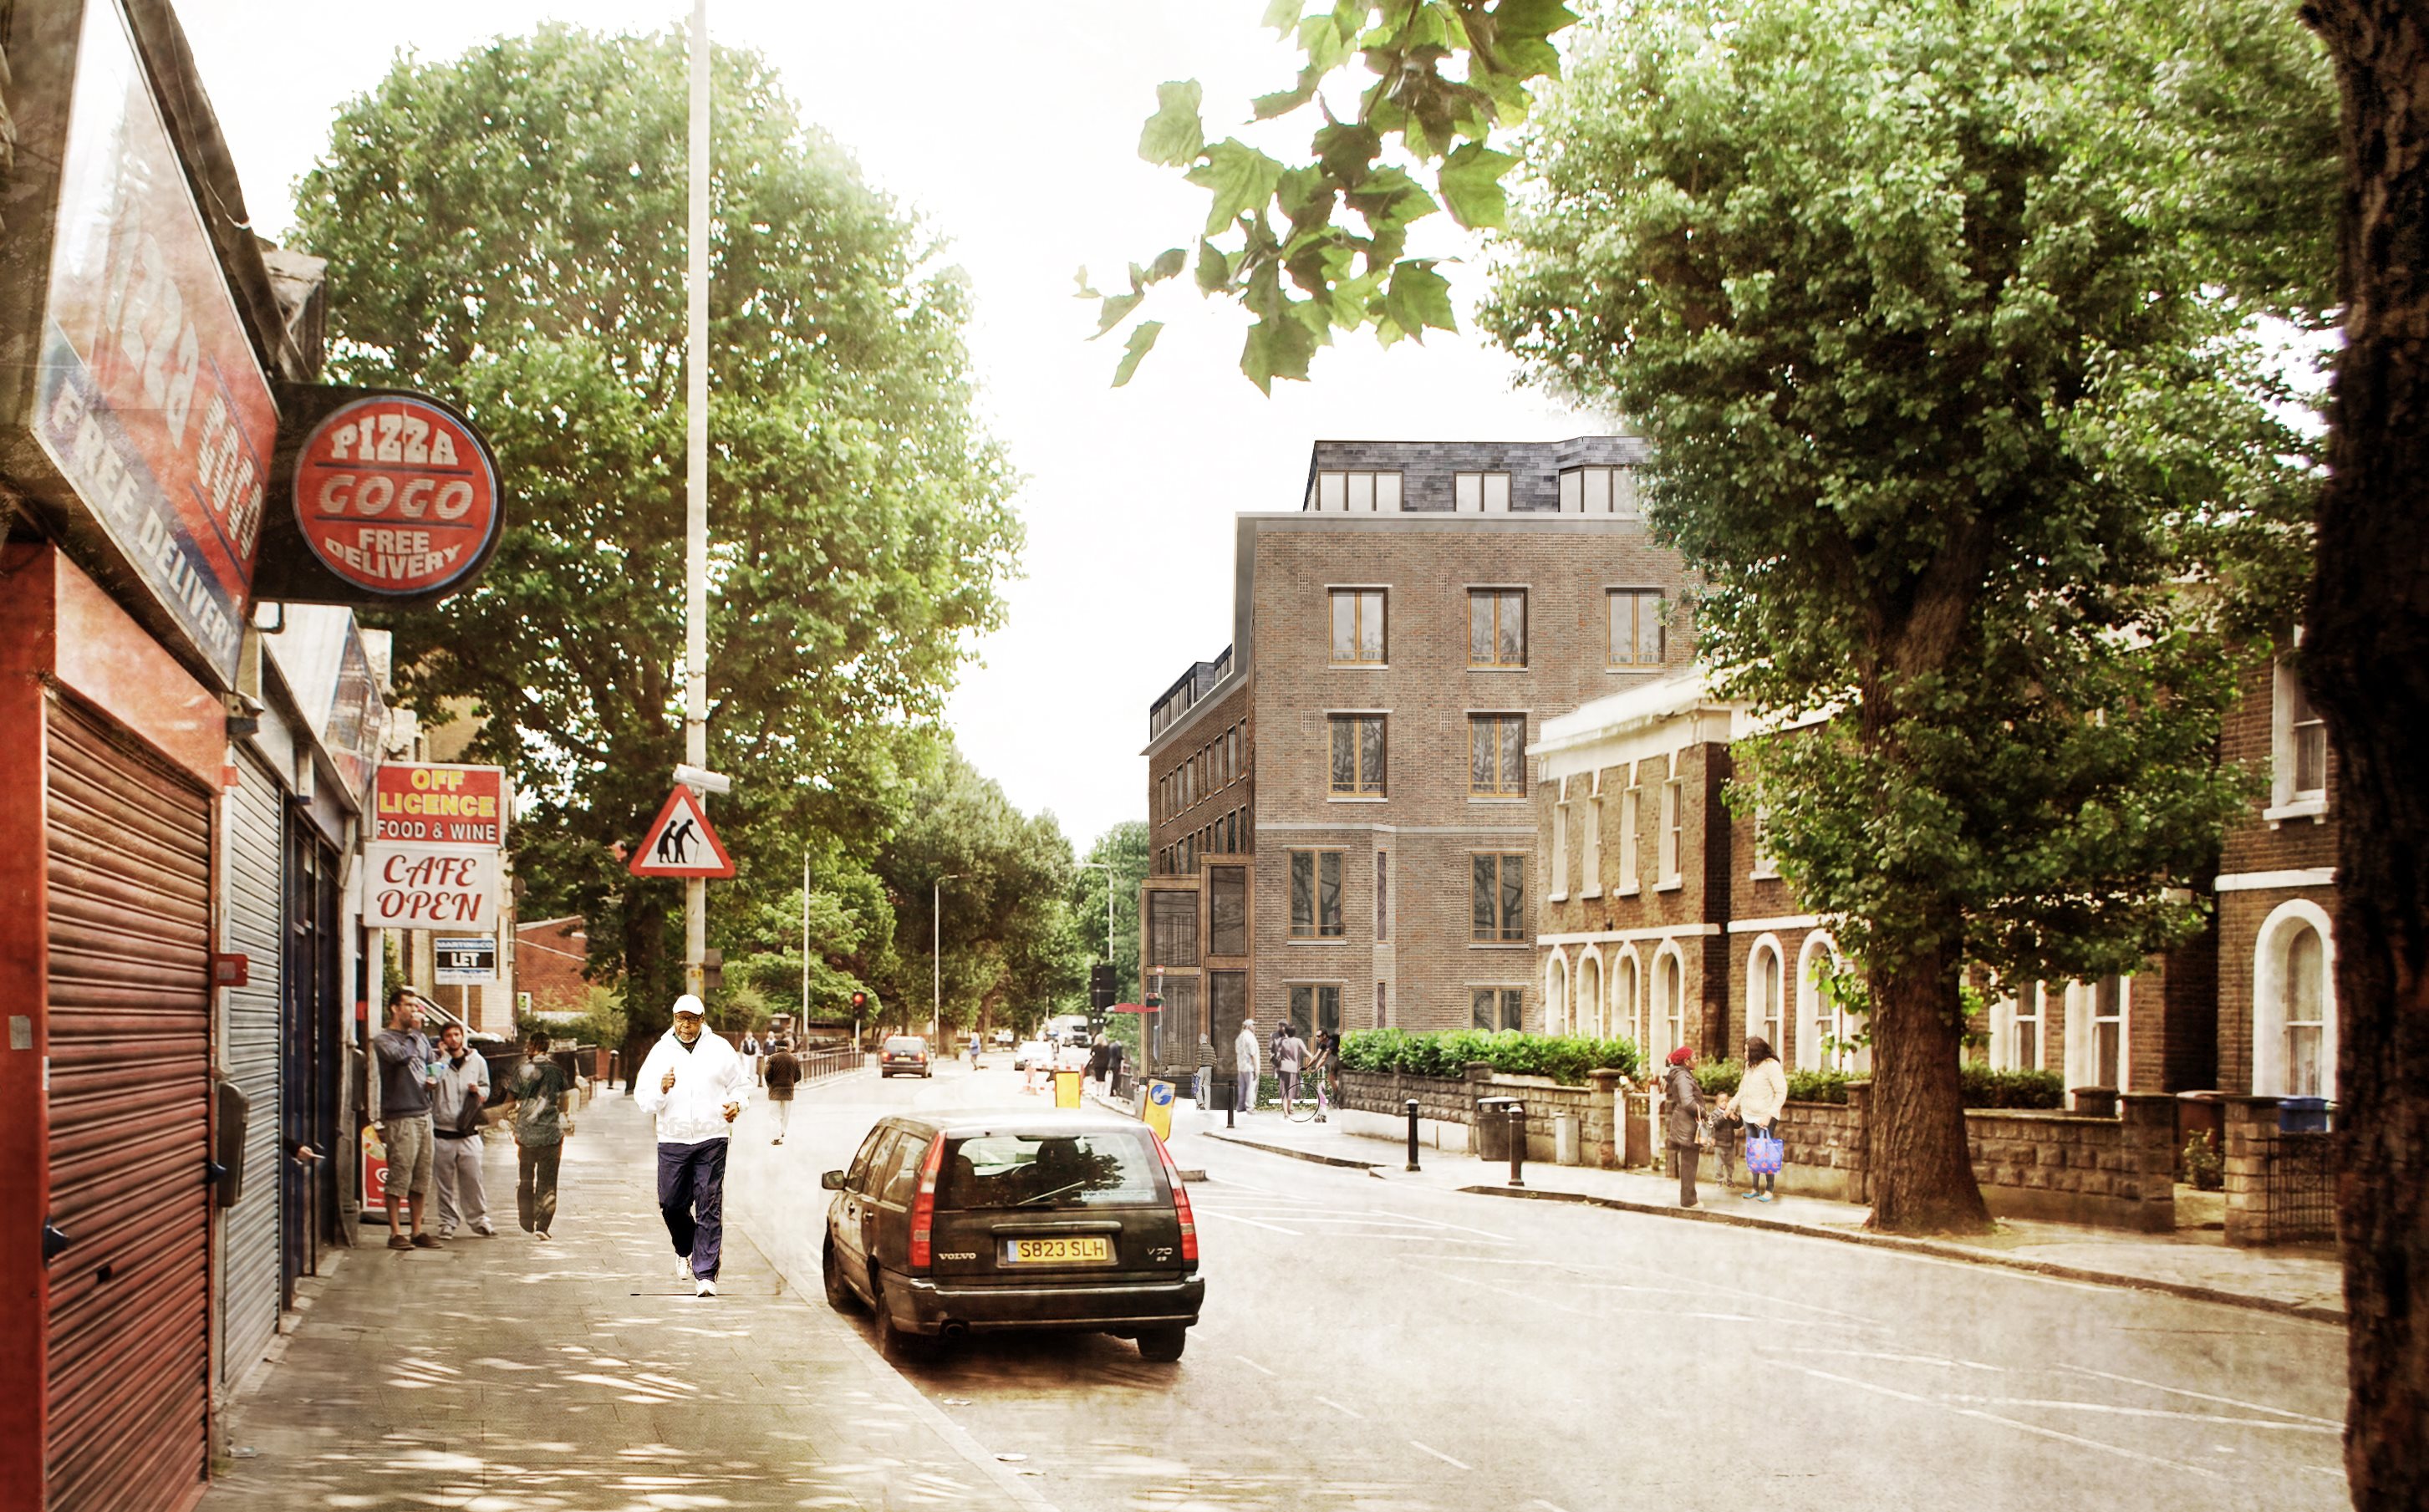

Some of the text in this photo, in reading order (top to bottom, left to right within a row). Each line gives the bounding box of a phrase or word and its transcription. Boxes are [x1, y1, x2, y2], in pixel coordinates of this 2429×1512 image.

[331, 414, 458, 466] PIZZA
[197, 391, 262, 561] GOGO
[318, 474, 474, 520] GOGO
[52, 379, 238, 659] FREE DELIVERY
[359, 528, 430, 555] FREE
[325, 537, 461, 579] DELIVERY
[410, 769, 466, 791] OFF
[379, 792, 496, 817] LICENCE
[377, 820, 496, 841] FOOD & WINE
[384, 855, 476, 888] CAFE
[377, 889, 481, 921] OPEN
[451, 952, 480, 967] LET
[939, 1252, 976, 1260] VOLVO
[1021, 1241, 1104, 1257] S823 SLH
